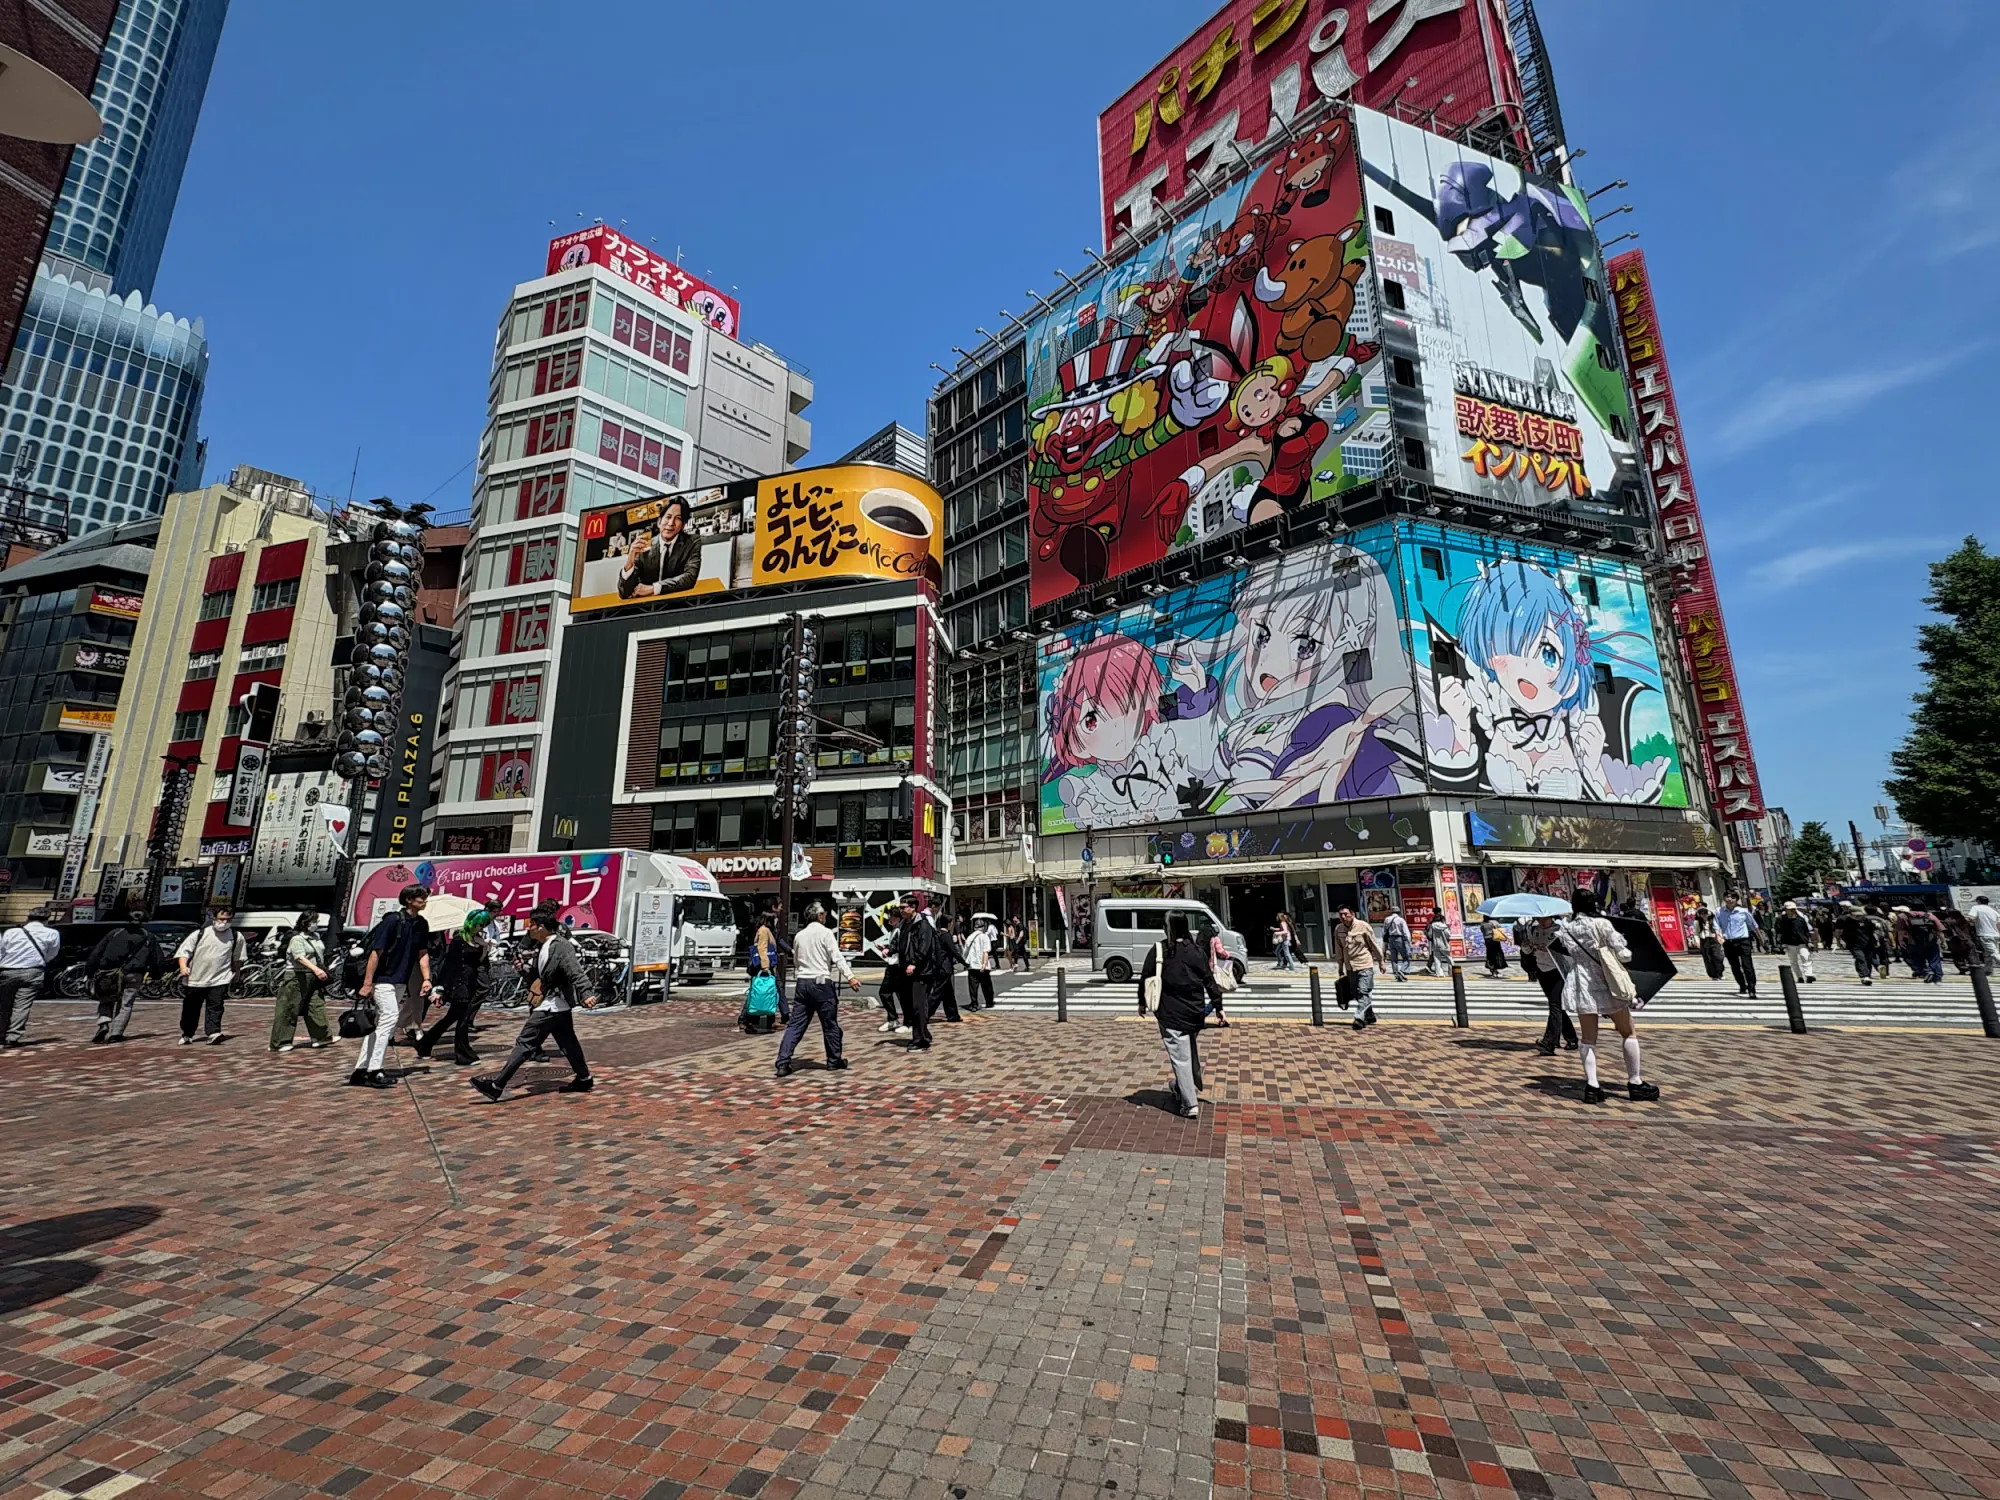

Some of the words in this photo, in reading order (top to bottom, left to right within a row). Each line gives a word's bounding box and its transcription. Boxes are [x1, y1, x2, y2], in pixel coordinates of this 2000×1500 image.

[552, 226, 603, 249] カラオケ歌広場
[604, 232, 694, 291] カラオケ
[609, 254, 680, 306] 歌広場
[1376, 255, 1417, 273] エスパス
[1615, 262, 1658, 361] パチンコ
[616, 317, 689, 361] カラオケ
[1450, 361, 1578, 423] EVANGELION
[602, 432, 660, 469] 歌広場
[870, 432, 894, 455] GRACERY
[1454, 395, 1584, 462] 歌舞伎町
[1635, 363, 1691, 512] エスパス
[1461, 437, 1592, 498] インパクト
[767, 501, 843, 548] コーヒー
[103, 657, 126, 667] BAG
[1688, 609, 1733, 703] パチンコ
[1707, 711, 1760, 815] エスパス
[232, 771, 253, 818] 一軒め酒場
[292, 808, 313, 869] 一軒め酒場
[448, 834, 484, 842] カラオケ
[450, 842, 480, 850] 歌広場
[450, 869, 483, 882] Tainyu
[484, 863, 528, 877] Chocolat
[706, 856, 812, 873] McDonas
[1406, 907, 1435, 916] エスパス
